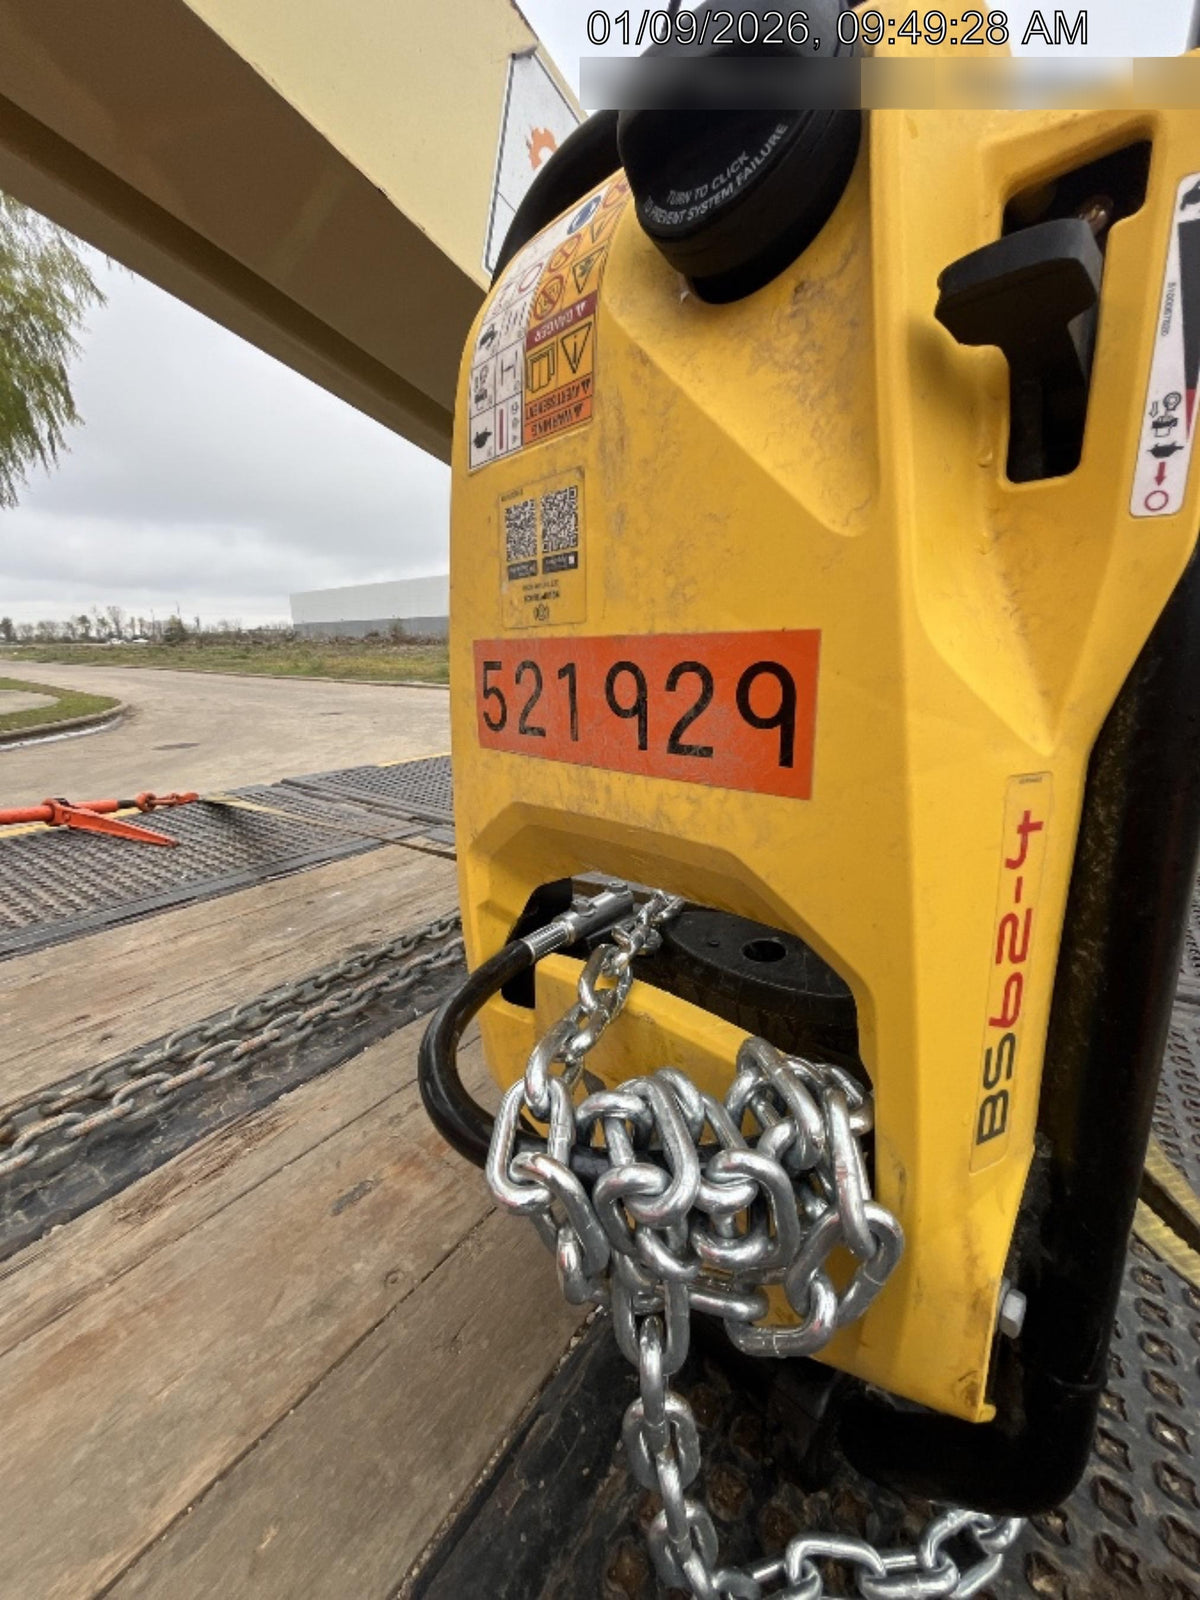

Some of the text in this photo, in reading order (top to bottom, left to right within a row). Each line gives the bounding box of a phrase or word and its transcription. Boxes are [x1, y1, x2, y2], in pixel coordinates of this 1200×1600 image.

[649, 205, 687, 225] PREVENT
[686, 182, 734, 222] SYSTEM
[735, 123, 789, 187] FAILURE
[667, 150, 750, 206] TURN TO CLICK
[532, 408, 573, 437] WARNING
[976, 809, 1044, 1146] BS62-4
